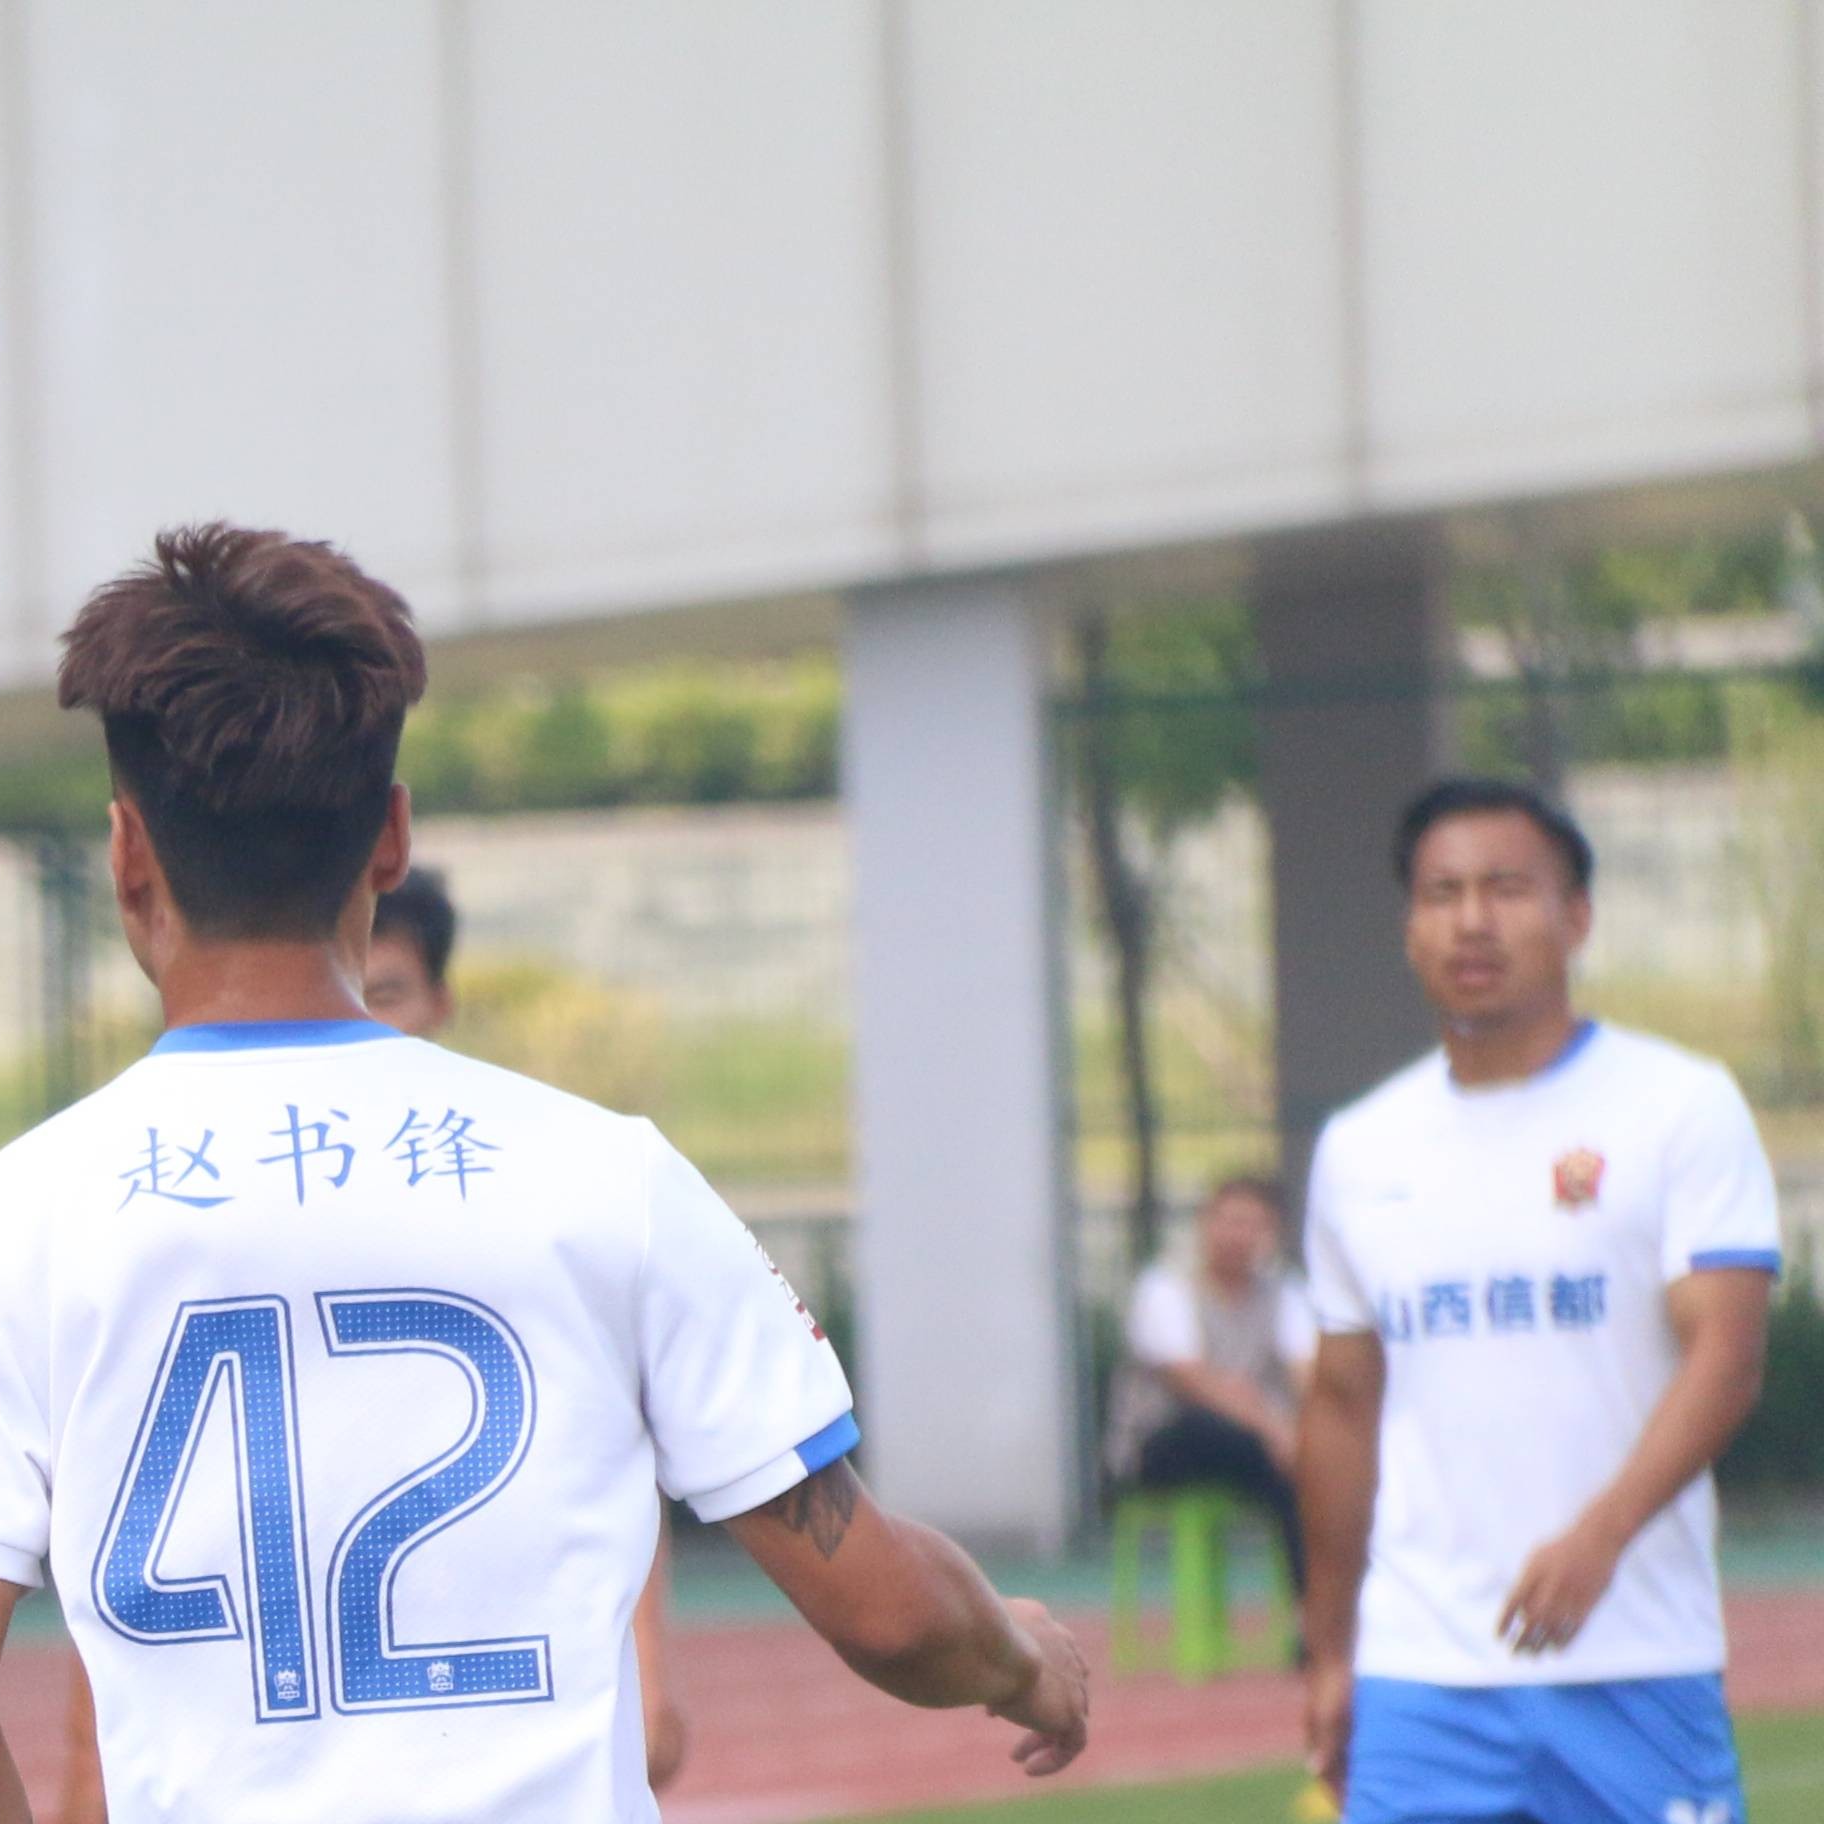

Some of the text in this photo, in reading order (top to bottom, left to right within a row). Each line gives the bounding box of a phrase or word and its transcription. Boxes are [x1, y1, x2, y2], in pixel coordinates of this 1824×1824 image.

[116, 1103, 504, 1214] 赵书锋
[1378, 1268, 1608, 1342] 山西信都
[91, 1287, 554, 1724] 42
